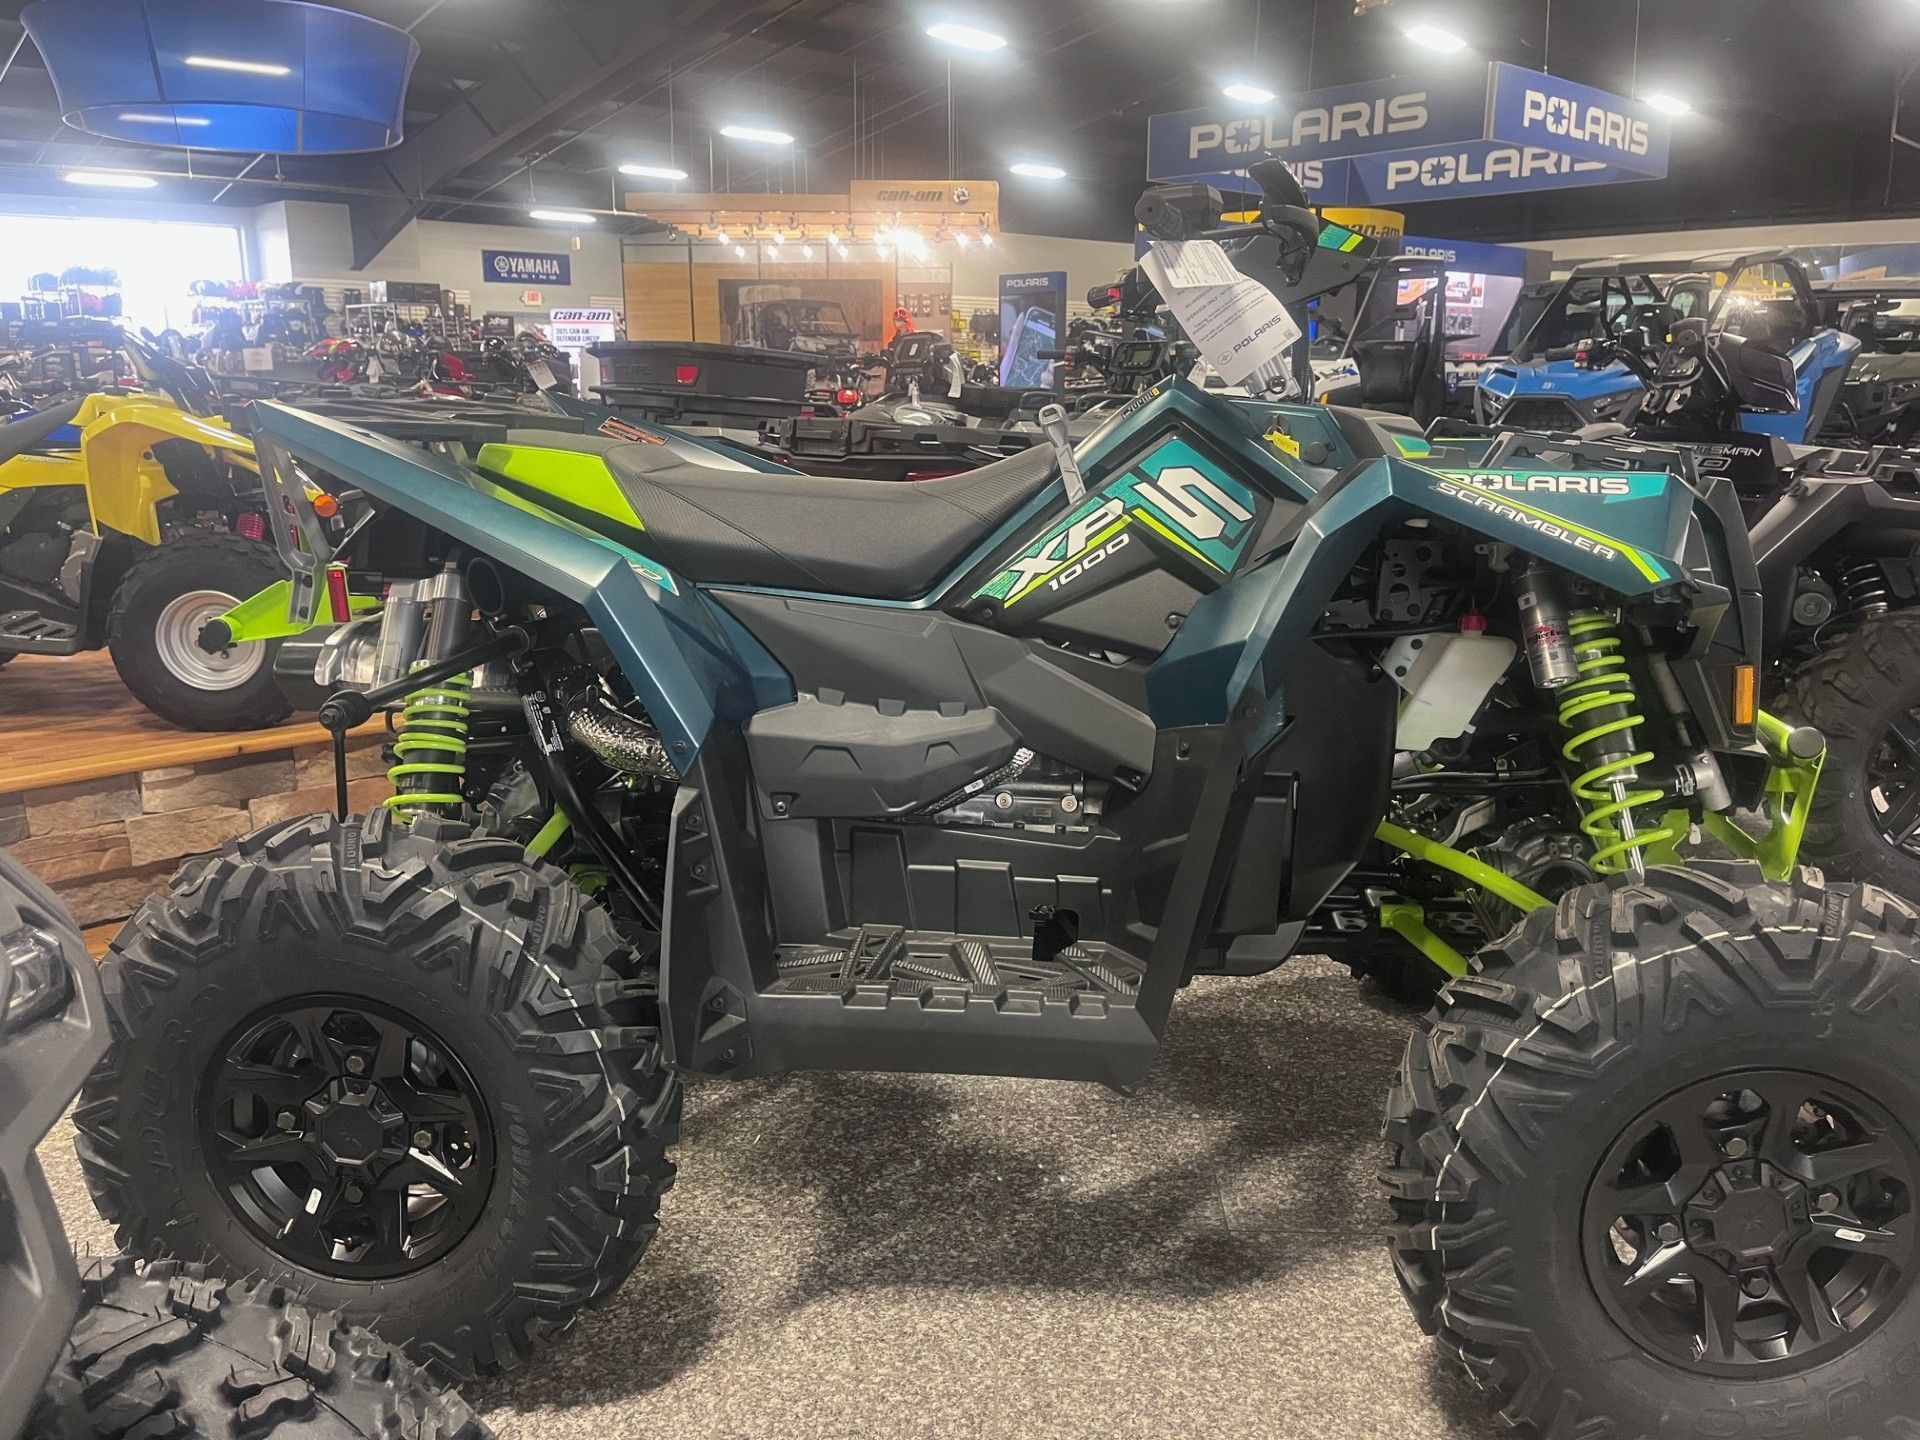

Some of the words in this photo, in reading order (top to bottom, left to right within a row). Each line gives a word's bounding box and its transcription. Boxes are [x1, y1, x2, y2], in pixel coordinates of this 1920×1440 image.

[1189, 92, 1428, 159] POLARIS
[1523, 89, 1649, 156] POLARIS
[877, 190, 943, 202] can-am
[1344, 223, 1401, 237] an-am
[500, 273, 557, 281] RACING
[510, 257, 560, 275] YAMAHA
[1006, 277, 1049, 289] POLARIS
[553, 311, 612, 321] can-am
[1233, 314, 1281, 353] POLARIS
[1435, 481, 1617, 562] SCRAMBLER
[1004, 497, 1125, 600] XP
[1048, 533, 1130, 592] 1000
